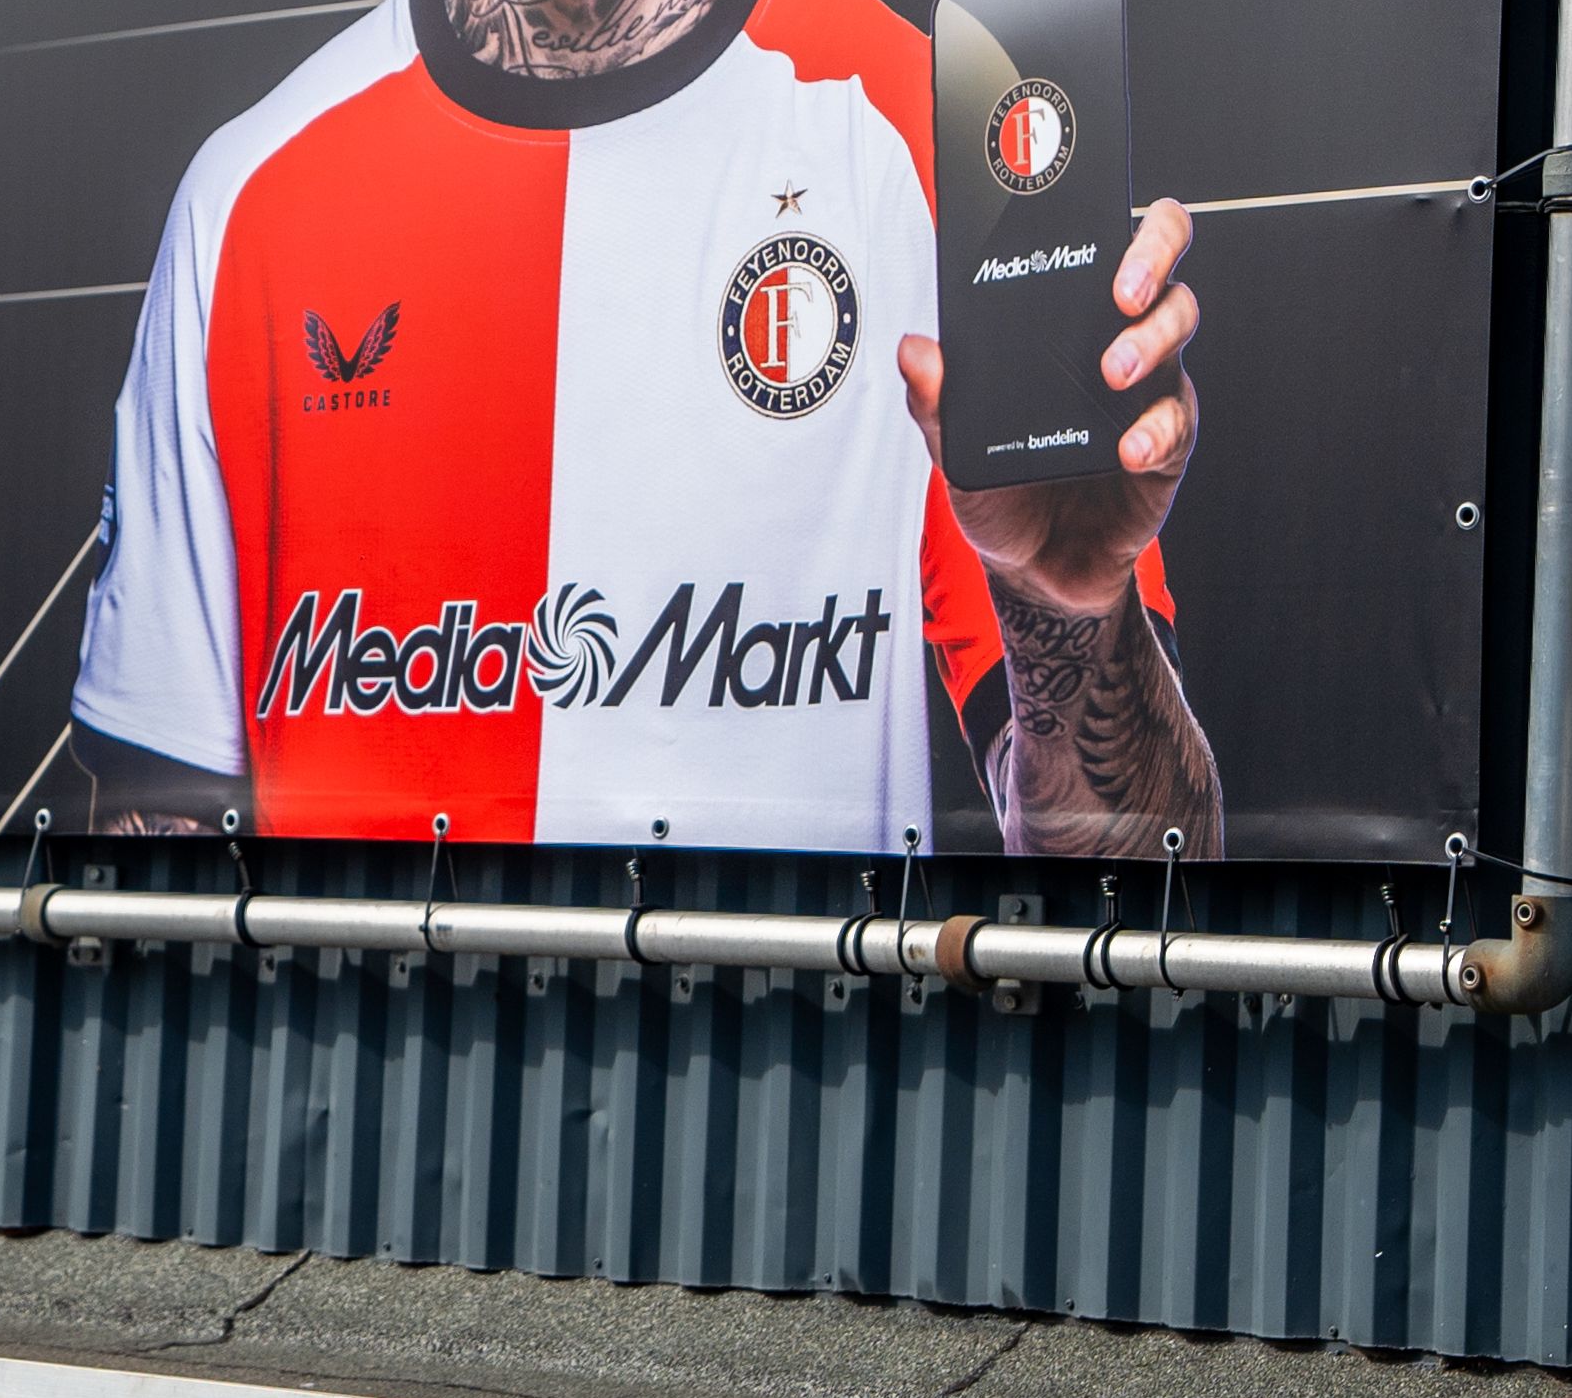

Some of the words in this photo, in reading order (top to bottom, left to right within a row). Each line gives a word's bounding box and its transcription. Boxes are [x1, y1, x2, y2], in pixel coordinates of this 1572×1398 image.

[991, 82, 1067, 128] FEYENOORD
[992, 144, 1069, 191] ROTTERDAM
[728, 239, 850, 305] FEYENOORD
[727, 341, 851, 411] ROTTERDAM
[302, 389, 391, 412] CASTORE
[1027, 428, 1089, 450] bundeling
